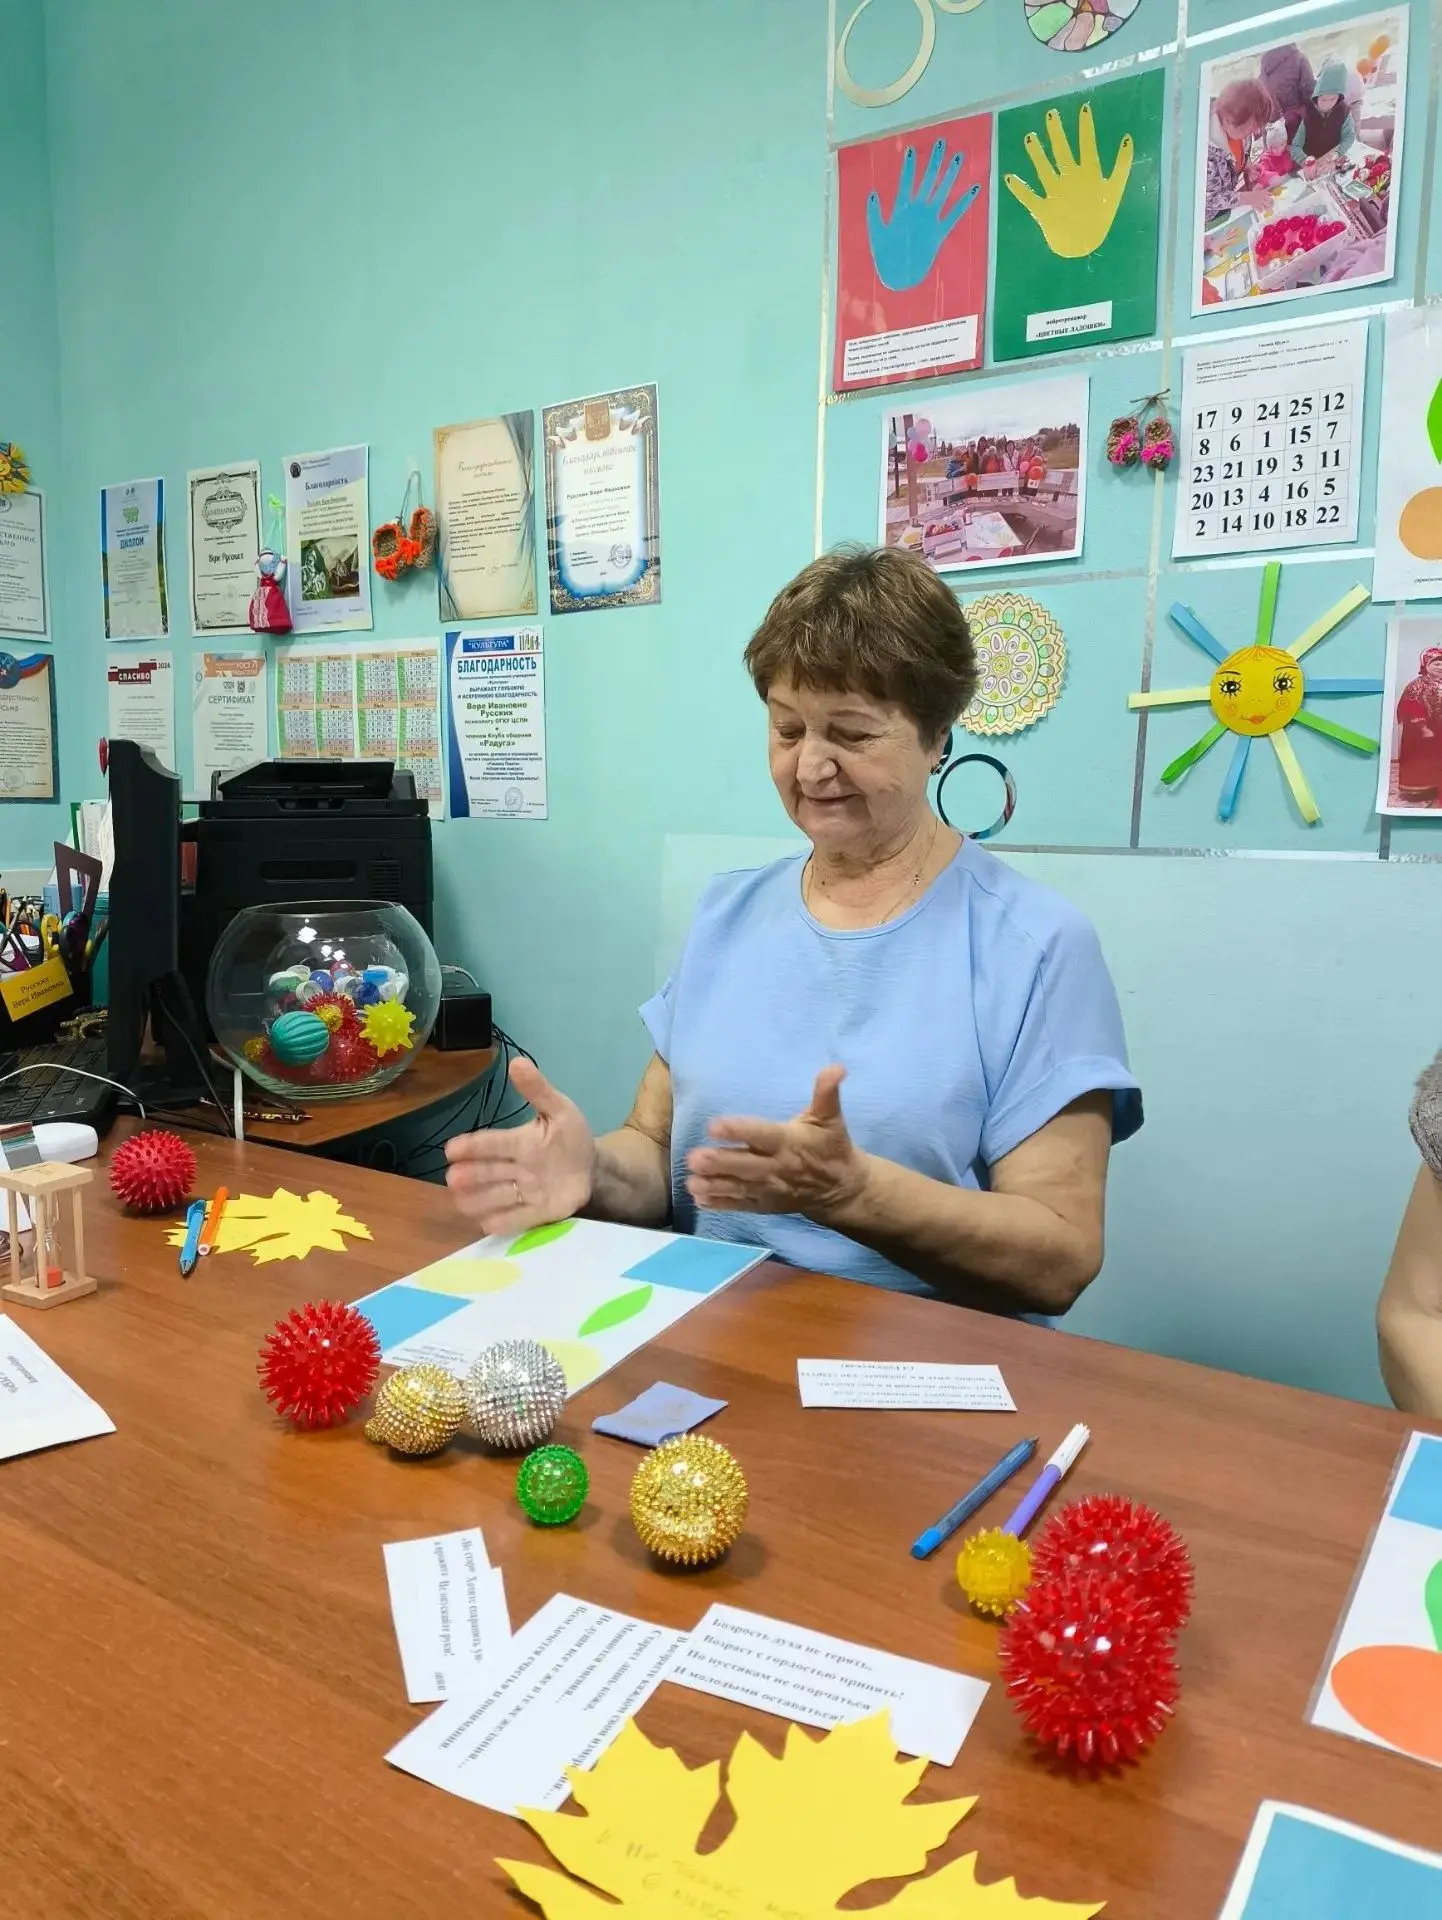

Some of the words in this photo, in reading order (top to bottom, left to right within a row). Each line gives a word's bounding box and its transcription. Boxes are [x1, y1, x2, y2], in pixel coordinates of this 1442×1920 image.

[1196, 410, 1217, 430] 17
[1231, 406, 1243, 424] 9
[1257, 402, 1280, 421] 24
[1289, 397, 1313, 417] 25
[1323, 392, 1345, 412] 12
[1199, 438, 1210, 455] 8
[1229, 433, 1241, 451] 6
[1263, 430, 1271, 448] 1
[1289, 425, 1312, 445] 15
[1326, 421, 1338, 440] 7
[1192, 464, 1214, 484] 23
[1222, 461, 1244, 480] 21
[1256, 457, 1278, 476] 19
[1291, 454, 1303, 472] 3
[1320, 449, 1340, 468] 11
[1191, 491, 1214, 511] 20
[1223, 488, 1244, 507] 13
[1258, 485, 1270, 502] 4
[1286, 481, 1309, 500] 16
[1323, 477, 1336, 496] 5
[1195, 519, 1206, 536] 2
[1222, 515, 1243, 533] 14
[1253, 511, 1275, 530] 10
[1285, 508, 1307, 527] 18
[1316, 505, 1340, 524] 22
[118, 672, 150, 681] СПАСИБО
[457, 656, 537, 674] БЛАГОДАРНОСТЬ
[208, 695, 255, 704] СЕРТИФИКАТ
[480, 710, 513, 718] Русских
[479, 739, 516, 748] «Радуга»
[563, 1606, 588, 1625] Всем
[533, 1625, 567, 1656] хочется
[593, 1622, 638, 1663] Меняются
[628, 1630, 662, 1660] Стареет
[805, 1645, 822, 1655] не
[646, 1643, 680, 1678] возрасте
[703, 1634, 753, 1655] Возраст
[766, 1655, 837, 1680] гордостью
[839, 1676, 905, 1700] принять!
[673, 1665, 687, 1675] И
[688, 1671, 759, 1696] молодыми
[761, 1693, 845, 1722] оставаться!
[686, 1649, 706, 1661] По
[708, 1658, 772, 1681] пустякам
[773, 1675, 790, 1687] не
[792, 1682, 871, 1711] огорчаться
